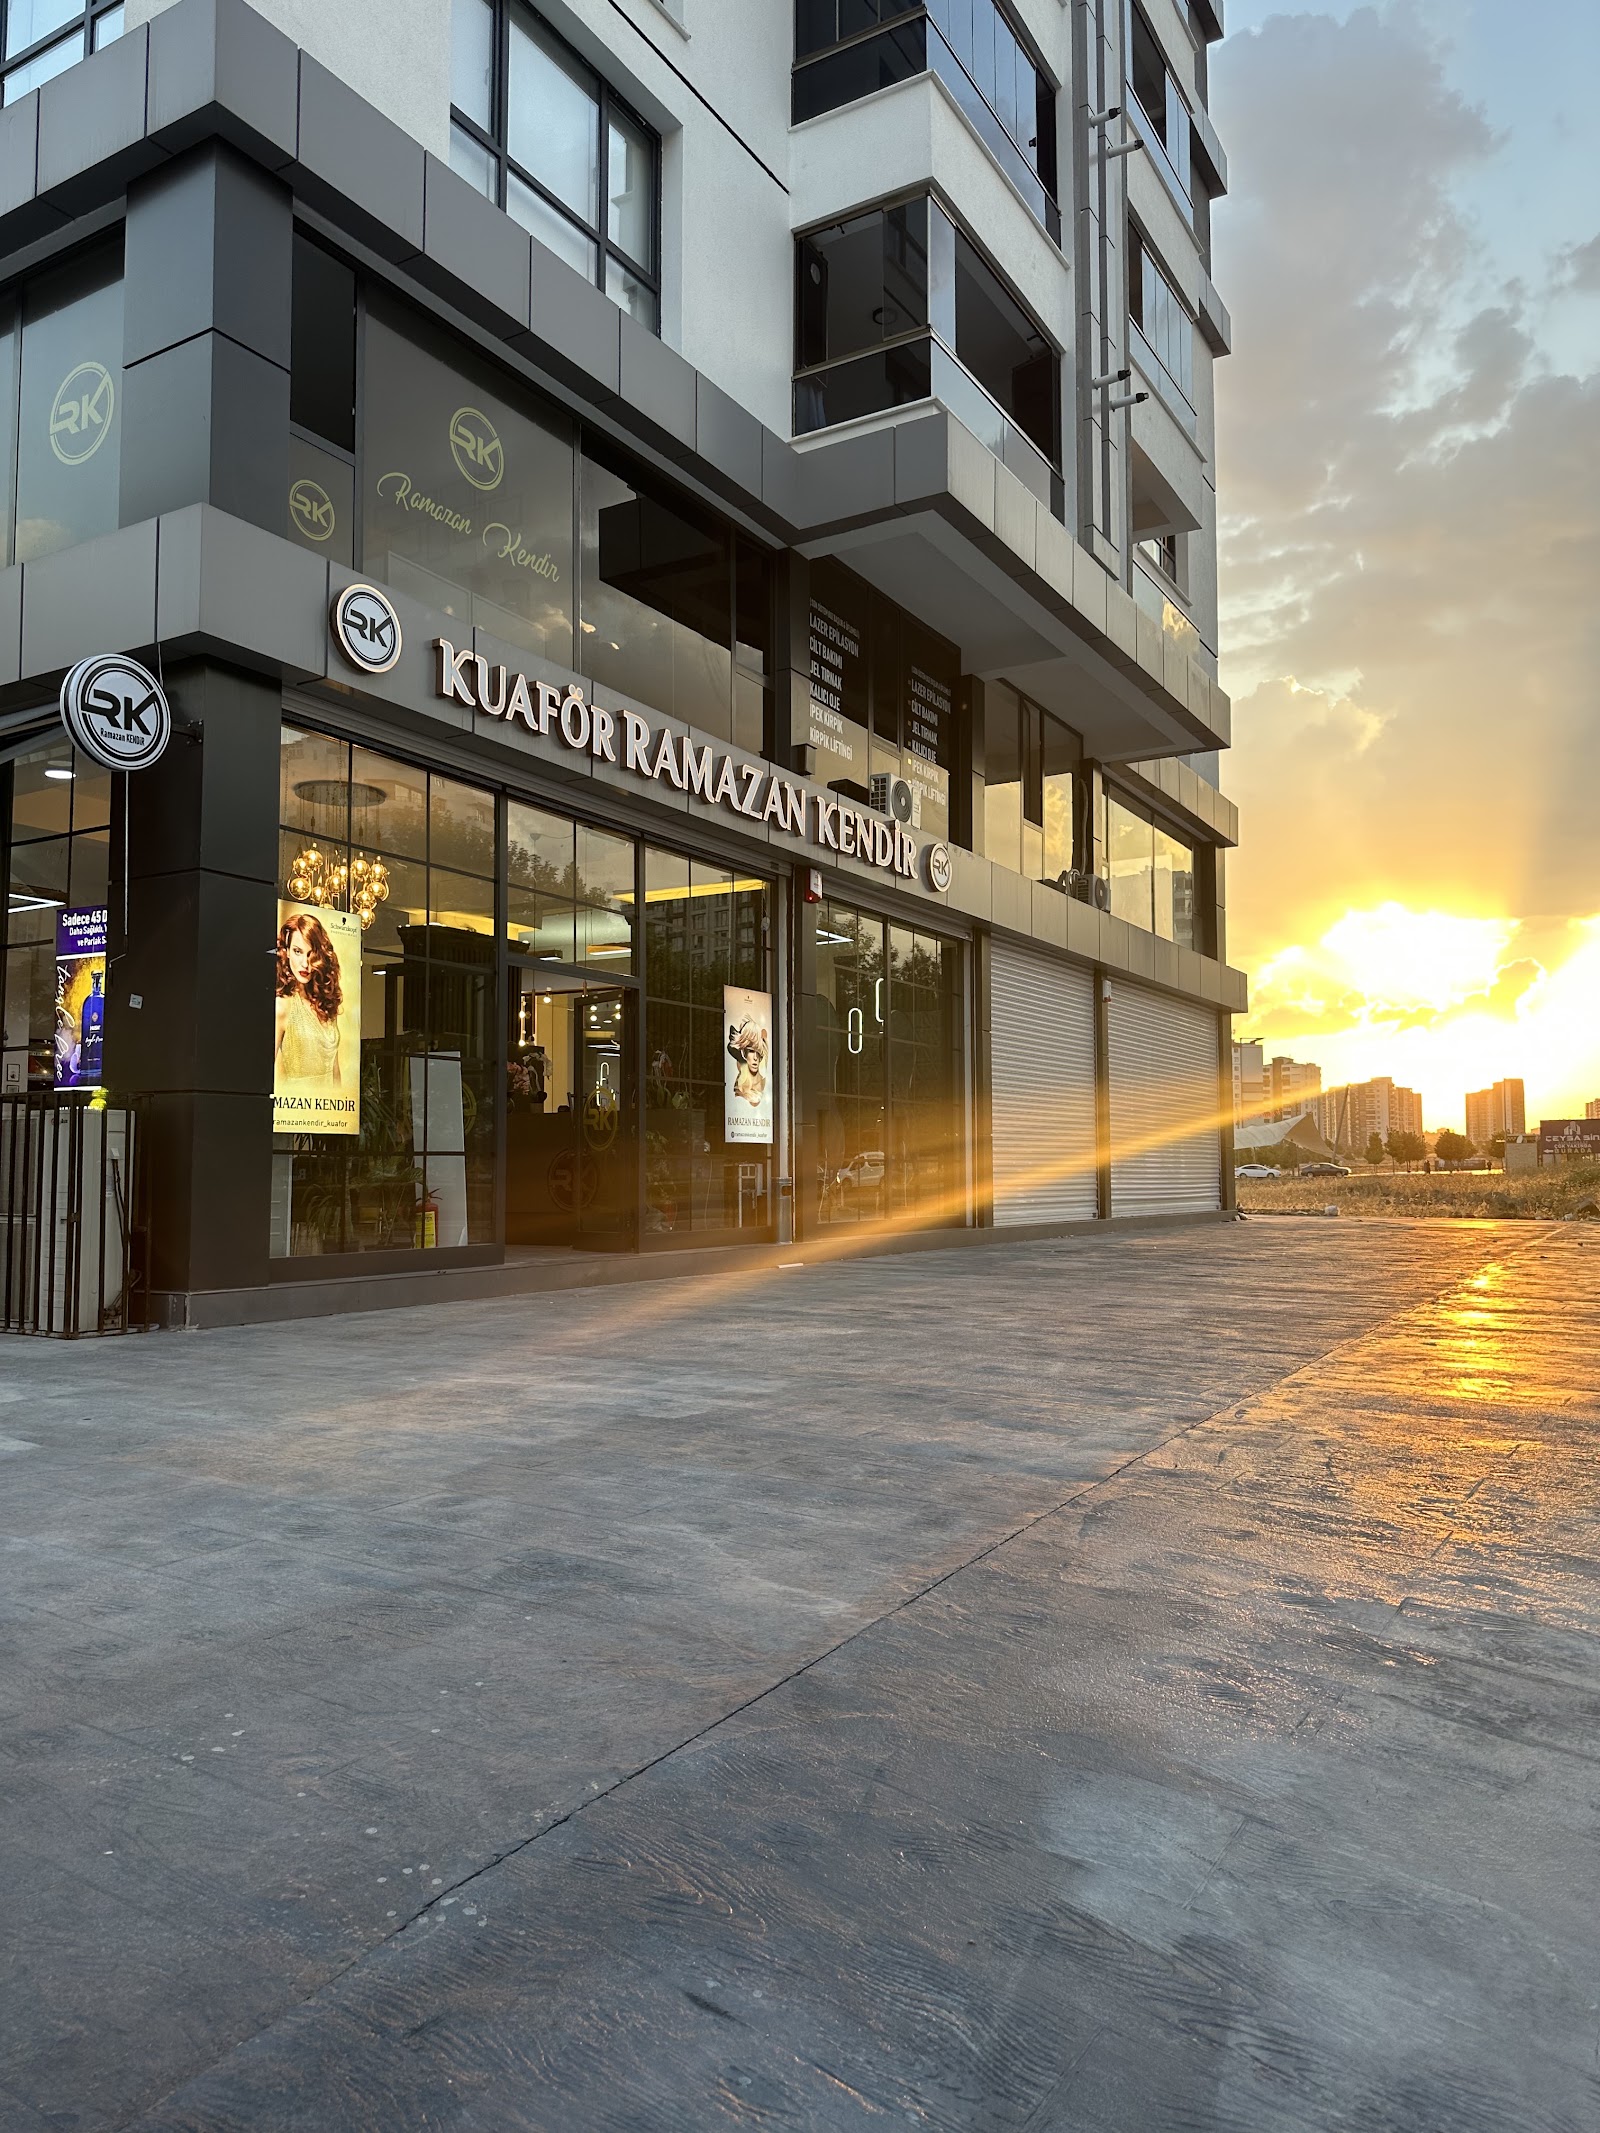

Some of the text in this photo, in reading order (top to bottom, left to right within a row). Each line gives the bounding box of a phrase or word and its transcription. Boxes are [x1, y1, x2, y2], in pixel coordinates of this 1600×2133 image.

[376, 471, 472, 535] Ramazan
[810, 612, 829, 638] LAZER
[810, 635, 822, 656] CİLT
[810, 660, 821, 678] JEL
[829, 692, 841, 712] OJE
[81, 688, 158, 736] RK
[100, 727, 126, 742] Ramazan
[433, 638, 918, 880] KUAFÖR RAMAZAN KENDİR
[62, 912, 90, 927] Sadece
[91, 910, 101, 924] 45
[70, 927, 82, 936] Daha
[315, 1096, 355, 1112] KENDİR
[727, 1117, 752, 1126] RAMAZAN
